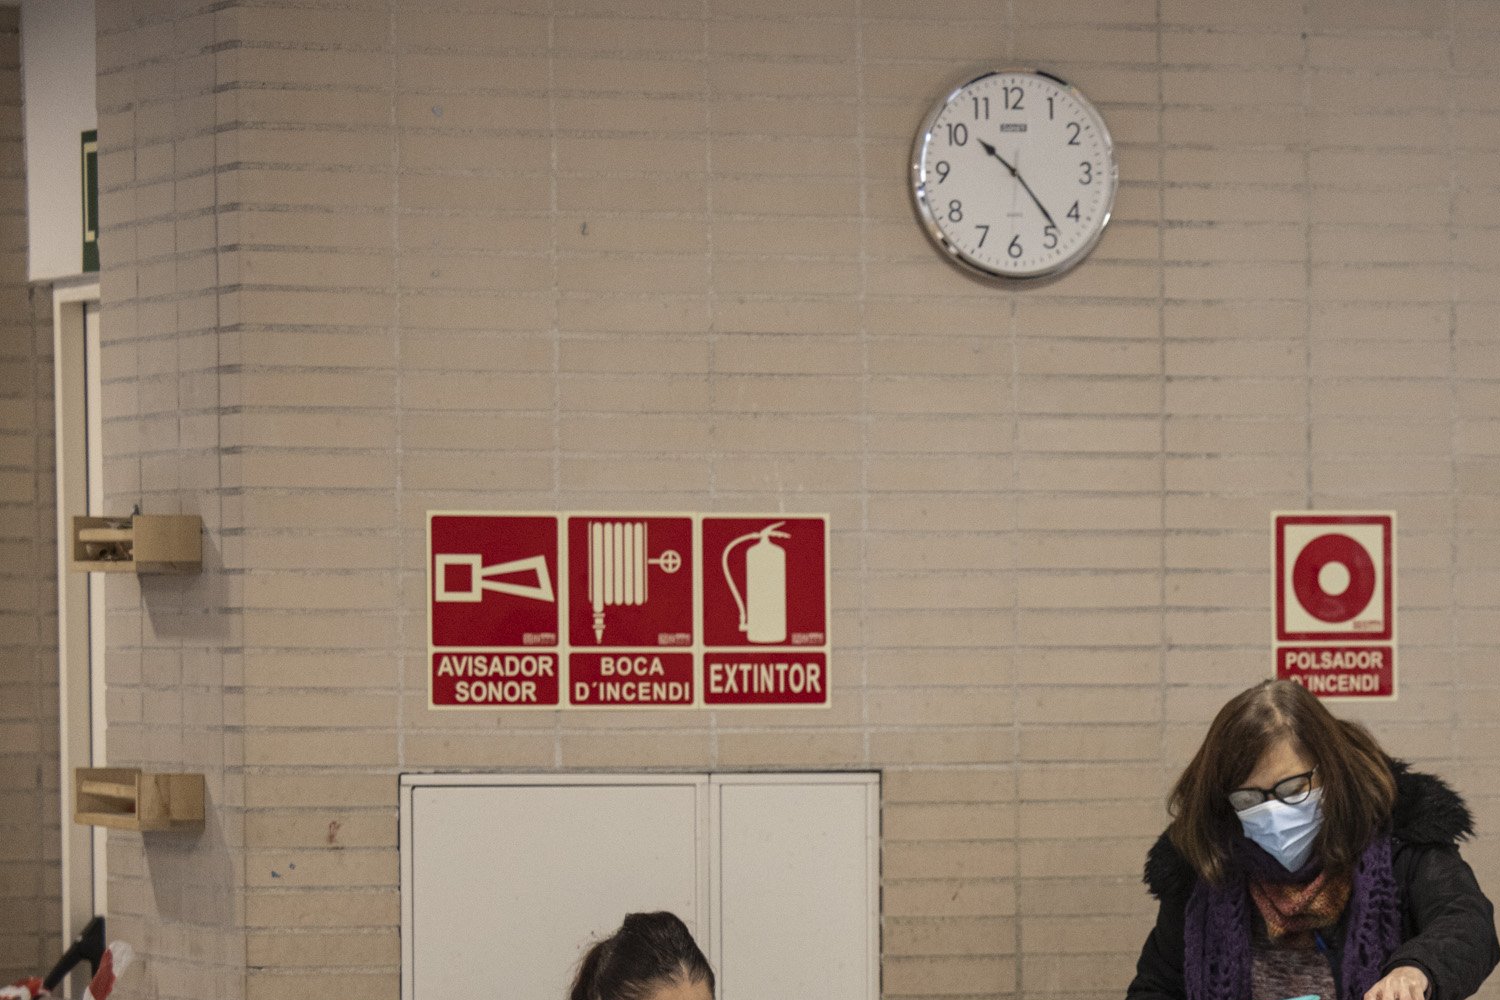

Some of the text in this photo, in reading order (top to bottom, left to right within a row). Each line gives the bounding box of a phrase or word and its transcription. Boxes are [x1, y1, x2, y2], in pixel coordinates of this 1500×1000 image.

[973, 96, 990, 120] 11
[1003, 86, 1025, 110] 12
[1047, 97, 1054, 120] 1
[947, 123, 969, 147] 10
[1067, 122, 1081, 145] 2
[935, 161, 950, 184] 9
[1079, 161, 1092, 185] 3
[948, 199, 963, 223] 8
[1066, 200, 1081, 223] 4
[975, 225, 990, 248] 7
[1007, 234, 1023, 258] 6
[1043, 225, 1058, 249] 5
[437, 655, 554, 677] AVISADOR
[600, 657, 665, 676] BOCA
[1285, 651, 1383, 669] POLSADOR
[709, 662, 822, 694] EXTINTOR
[454, 680, 538, 702] SONOR
[574, 681, 691, 701] D'INCENDI
